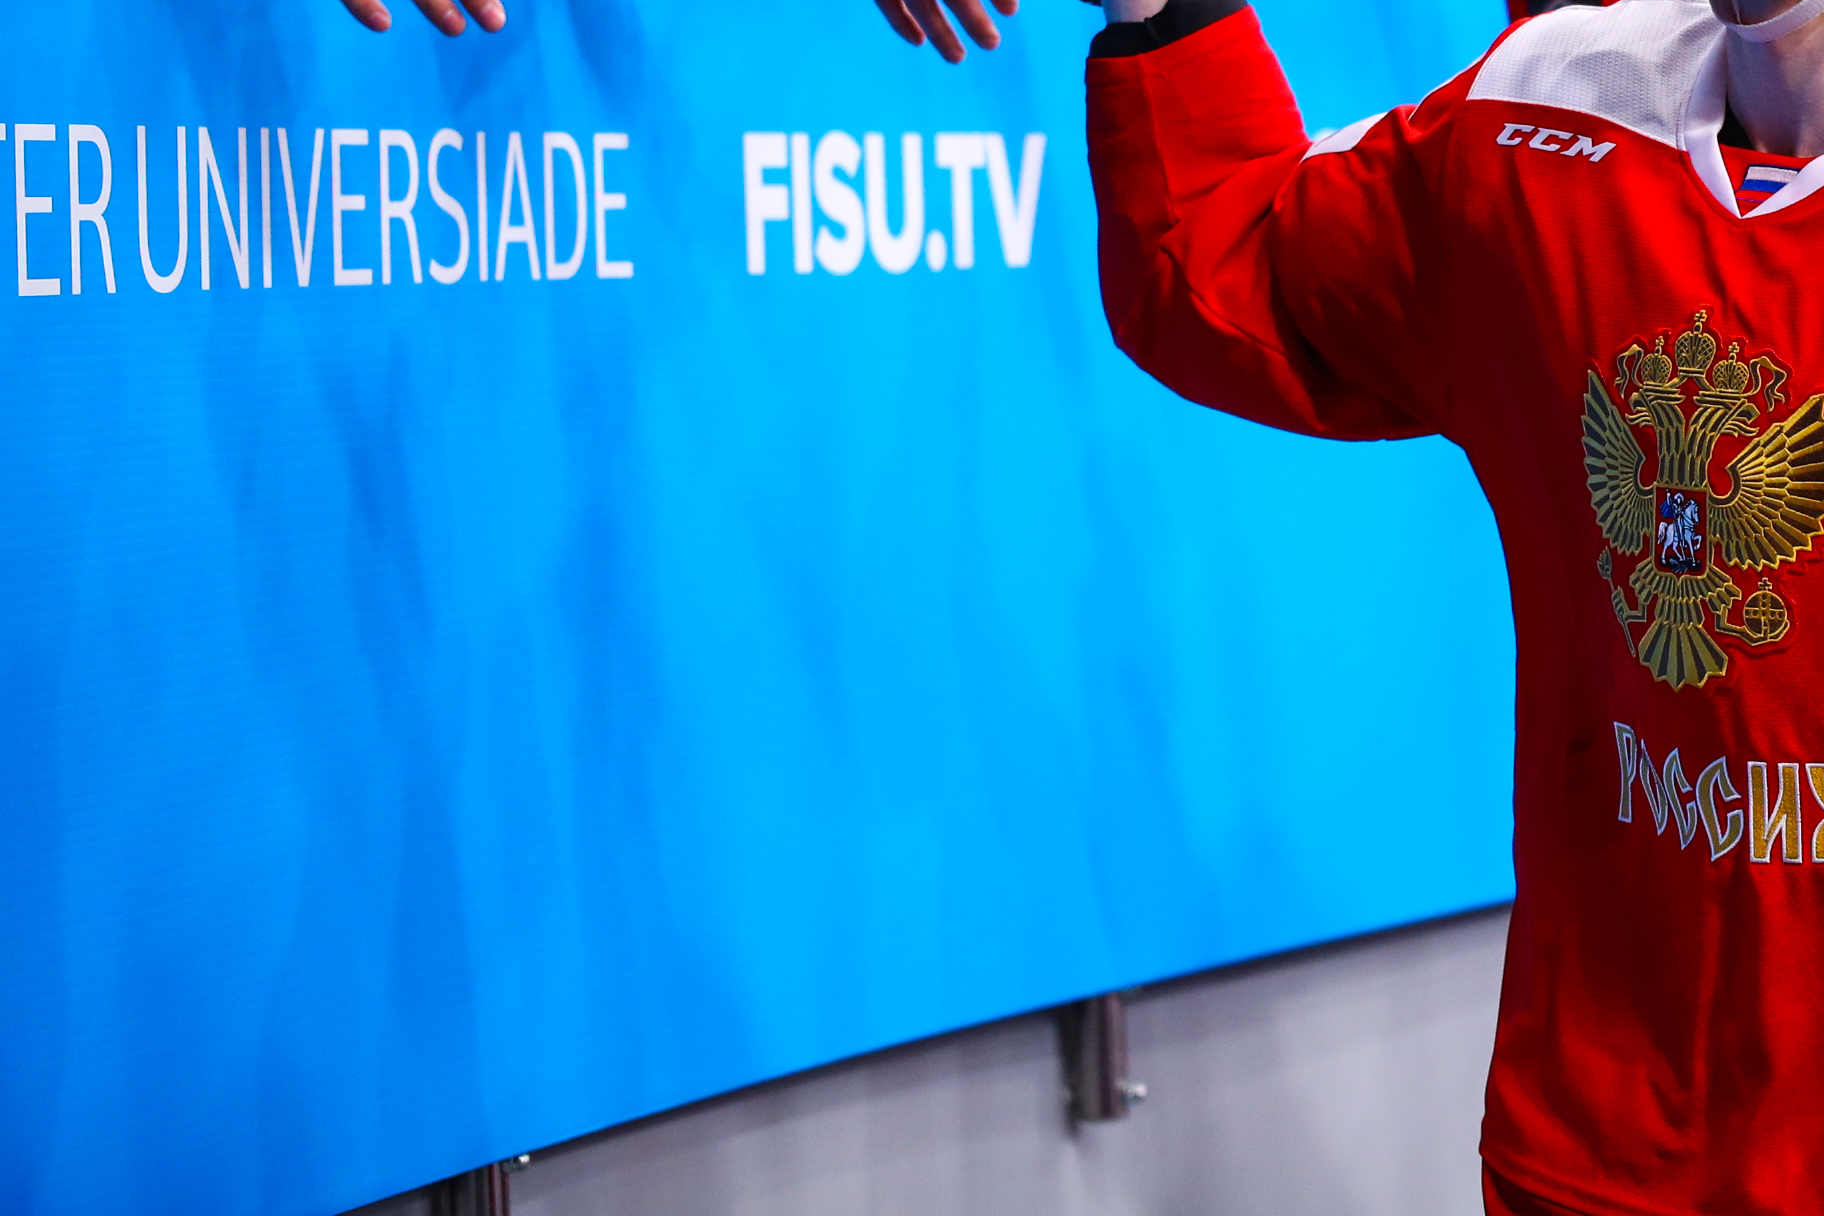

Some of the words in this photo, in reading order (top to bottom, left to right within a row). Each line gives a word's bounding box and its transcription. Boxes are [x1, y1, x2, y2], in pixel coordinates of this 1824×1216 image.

[0, 122, 117, 297] ER
[136, 124, 635, 295] UNIVERSIADE
[742, 130, 1048, 277] FISU.TV
[1496, 122, 1617, 163] CCM
